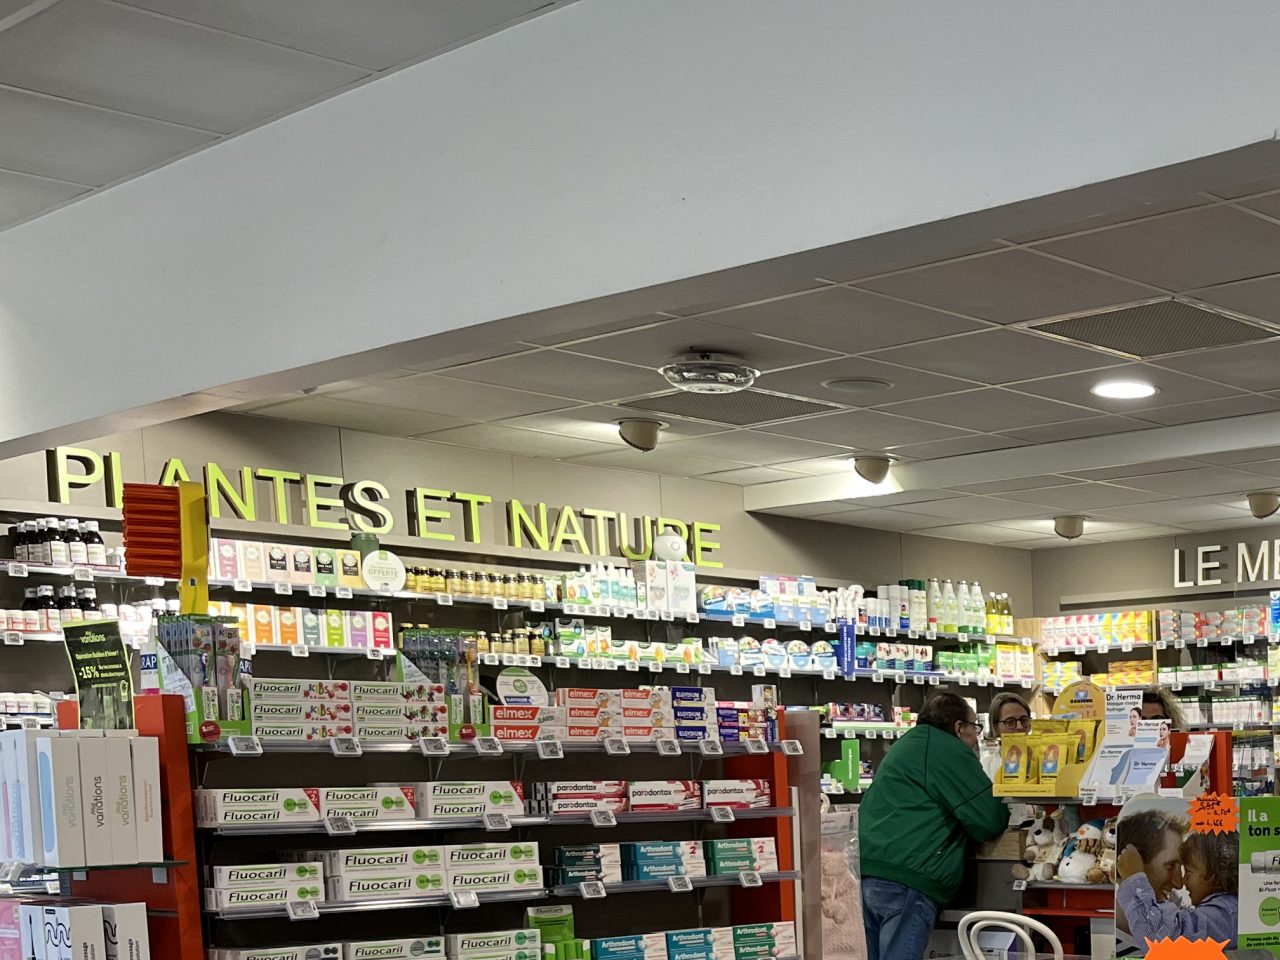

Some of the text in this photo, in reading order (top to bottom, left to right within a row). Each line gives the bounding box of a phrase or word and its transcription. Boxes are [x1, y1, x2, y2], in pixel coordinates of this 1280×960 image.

[414, 487, 493, 544] ET
[507, 498, 724, 569] NATURE
[1174, 544, 1222, 588] LE
[254, 682, 301, 693] Fluocaril
[353, 685, 398, 696] Fluocaril
[569, 690, 594, 699] elmex
[495, 707, 532, 719] elmex
[556, 783, 596, 793] parodontax
[707, 786, 745, 797] parodontax
[95, 775, 103, 828] variations
[222, 792, 279, 803] Fluocaril
[1260, 812, 1268, 822] a
[1248, 826, 1271, 836] ton
[450, 848, 506, 862] Fluocaril
[640, 845, 674, 855] Arthrodont
[345, 853, 408, 866] Fluocaril
[228, 868, 287, 881] Fluocaril
[736, 926, 767, 936] Arthrodont
